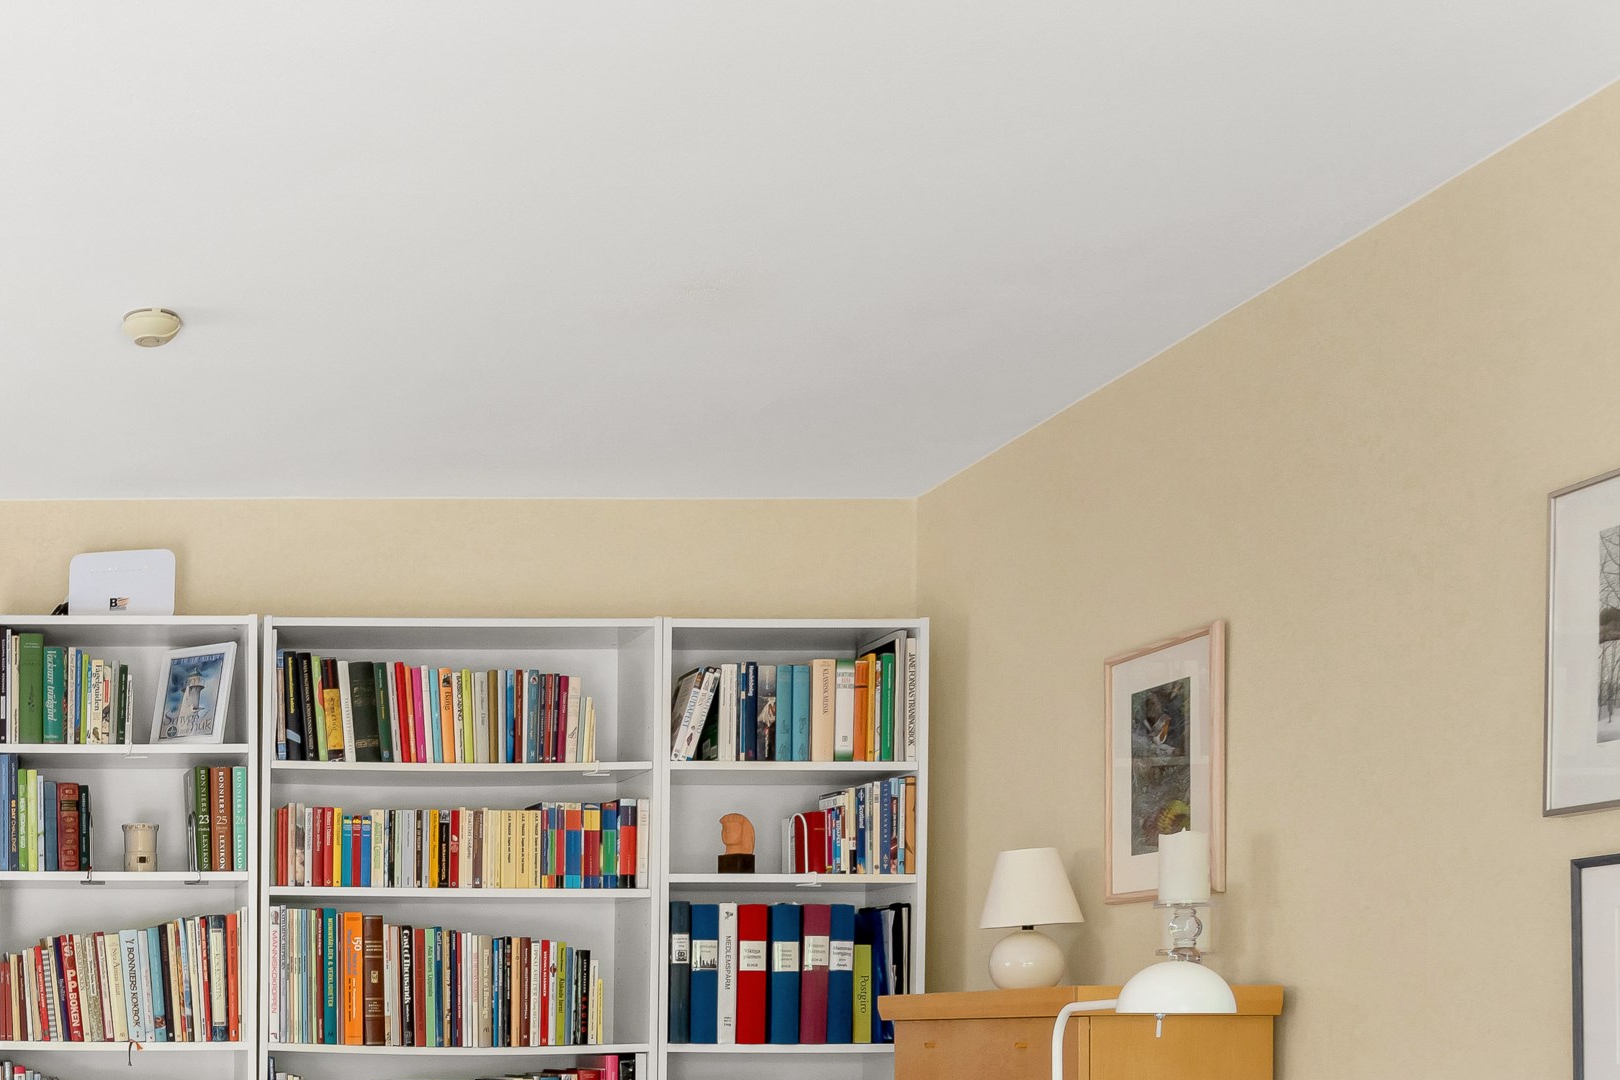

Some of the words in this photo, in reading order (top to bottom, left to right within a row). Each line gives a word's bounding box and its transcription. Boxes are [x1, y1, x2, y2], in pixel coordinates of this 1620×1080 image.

[110, 598, 118, 608] B
[92, 665, 103, 711] Fågelguiden
[444, 691, 452, 711] Bang
[682, 690, 700, 729] BUDAPEST
[696, 694, 713, 734] SKOTTLAND
[198, 815, 209, 824] 23
[216, 816, 228, 825] 25
[352, 937, 362, 952] 150
[403, 944, 410, 952] of
[75, 942, 85, 991] DESSERTBOKEN
[127, 947, 138, 991] BONNIERS
[426, 974, 434, 997] Uppsala
[484, 978, 490, 986] år
[856, 975, 870, 1014] Postgiro
[131, 992, 141, 1028] KOKBOK
